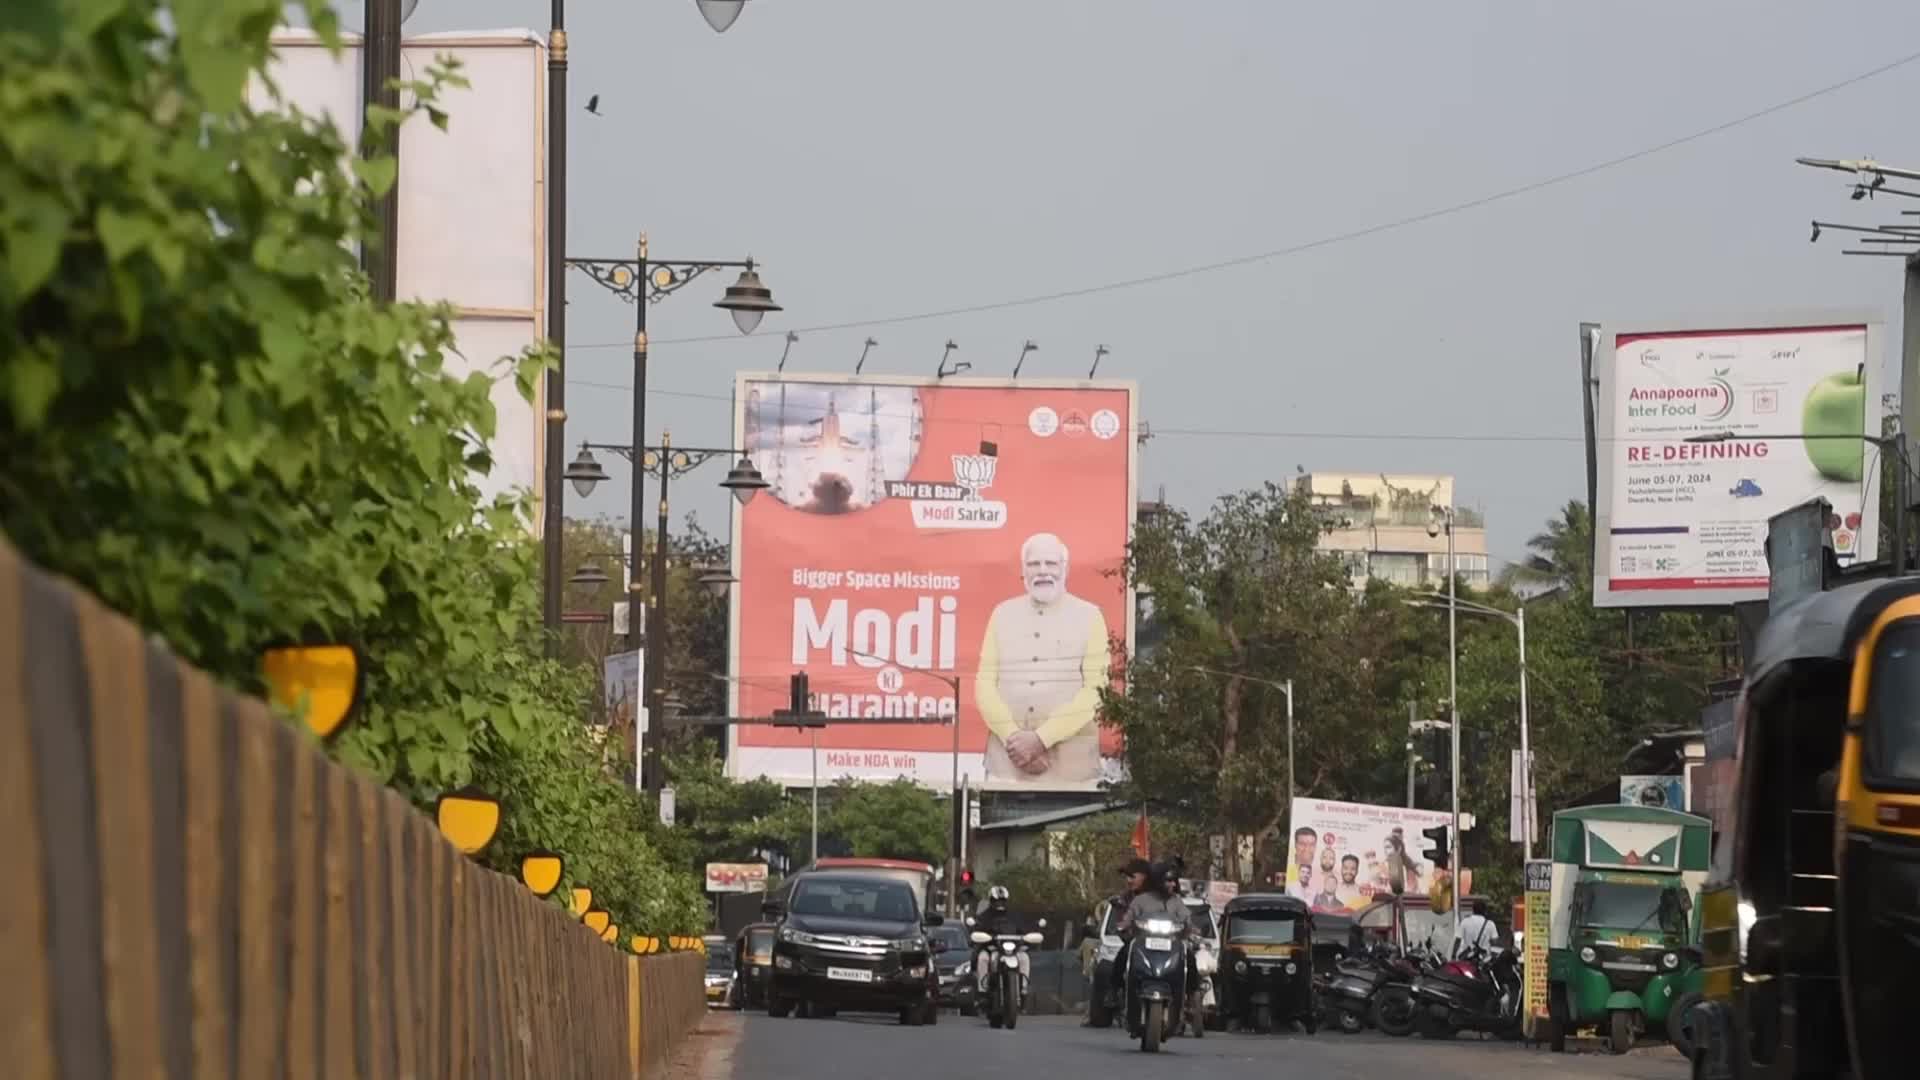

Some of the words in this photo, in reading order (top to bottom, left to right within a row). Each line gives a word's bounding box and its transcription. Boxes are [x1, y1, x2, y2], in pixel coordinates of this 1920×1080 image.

[1629, 386, 1718, 402] Annapoorna
[1628, 405, 1659, 417] Inter
[1662, 404, 1696, 416] Food
[1628, 442, 1769, 461] RE-DEFINING
[1628, 475, 1651, 485] June
[1687, 473, 1711, 483] 2024
[891, 483, 916, 497] Phir
[918, 485, 932, 498] Ek
[922, 506, 954, 520] Modi
[957, 507, 1000, 521] Sarkar
[792, 568, 843, 589] Bigger
[846, 571, 891, 590] Space
[893, 571, 961, 590] Missions
[792, 596, 957, 670] Modi
[789, 691, 957, 721] uarantee
[826, 752, 860, 768] Make
[864, 754, 890, 768] NDA
[893, 754, 916, 769] win
